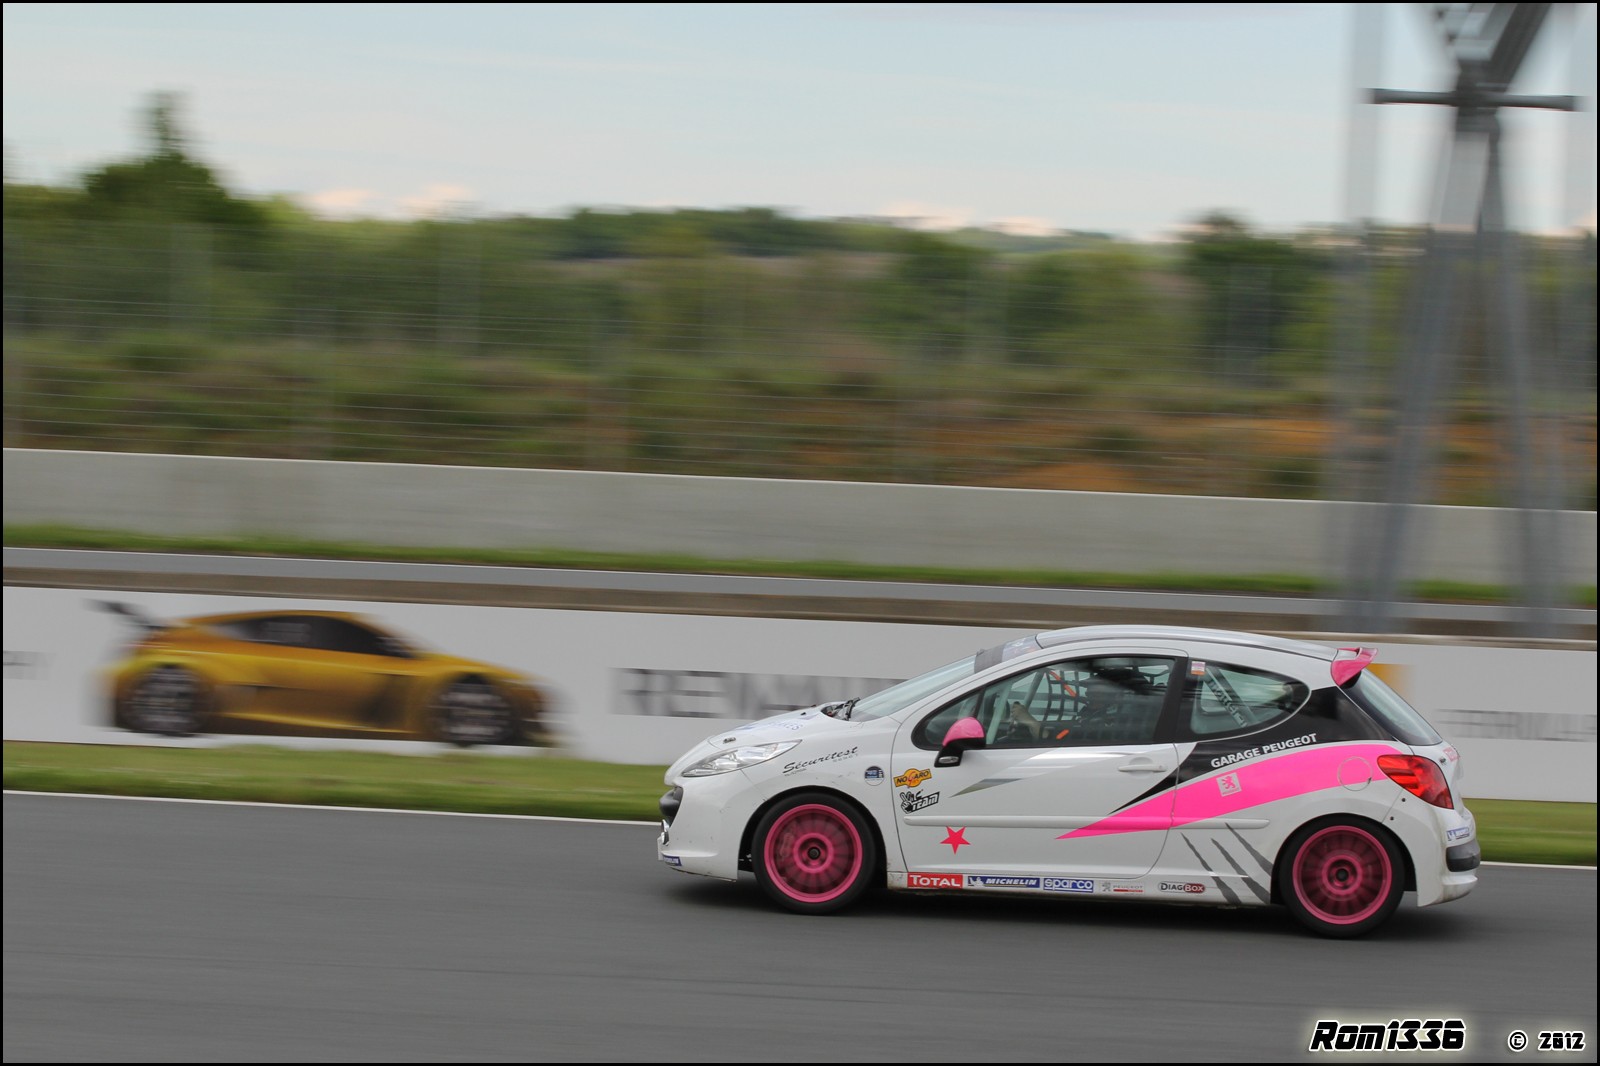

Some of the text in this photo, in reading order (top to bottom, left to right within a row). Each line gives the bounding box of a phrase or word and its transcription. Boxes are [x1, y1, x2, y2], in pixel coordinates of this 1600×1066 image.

[1211, 733, 1317, 768] GARAGE PEUGEOT
[909, 875, 961, 887] TOTAL
[985, 877, 1037, 886] MICHELIN
[1045, 878, 1093, 890] sparco
